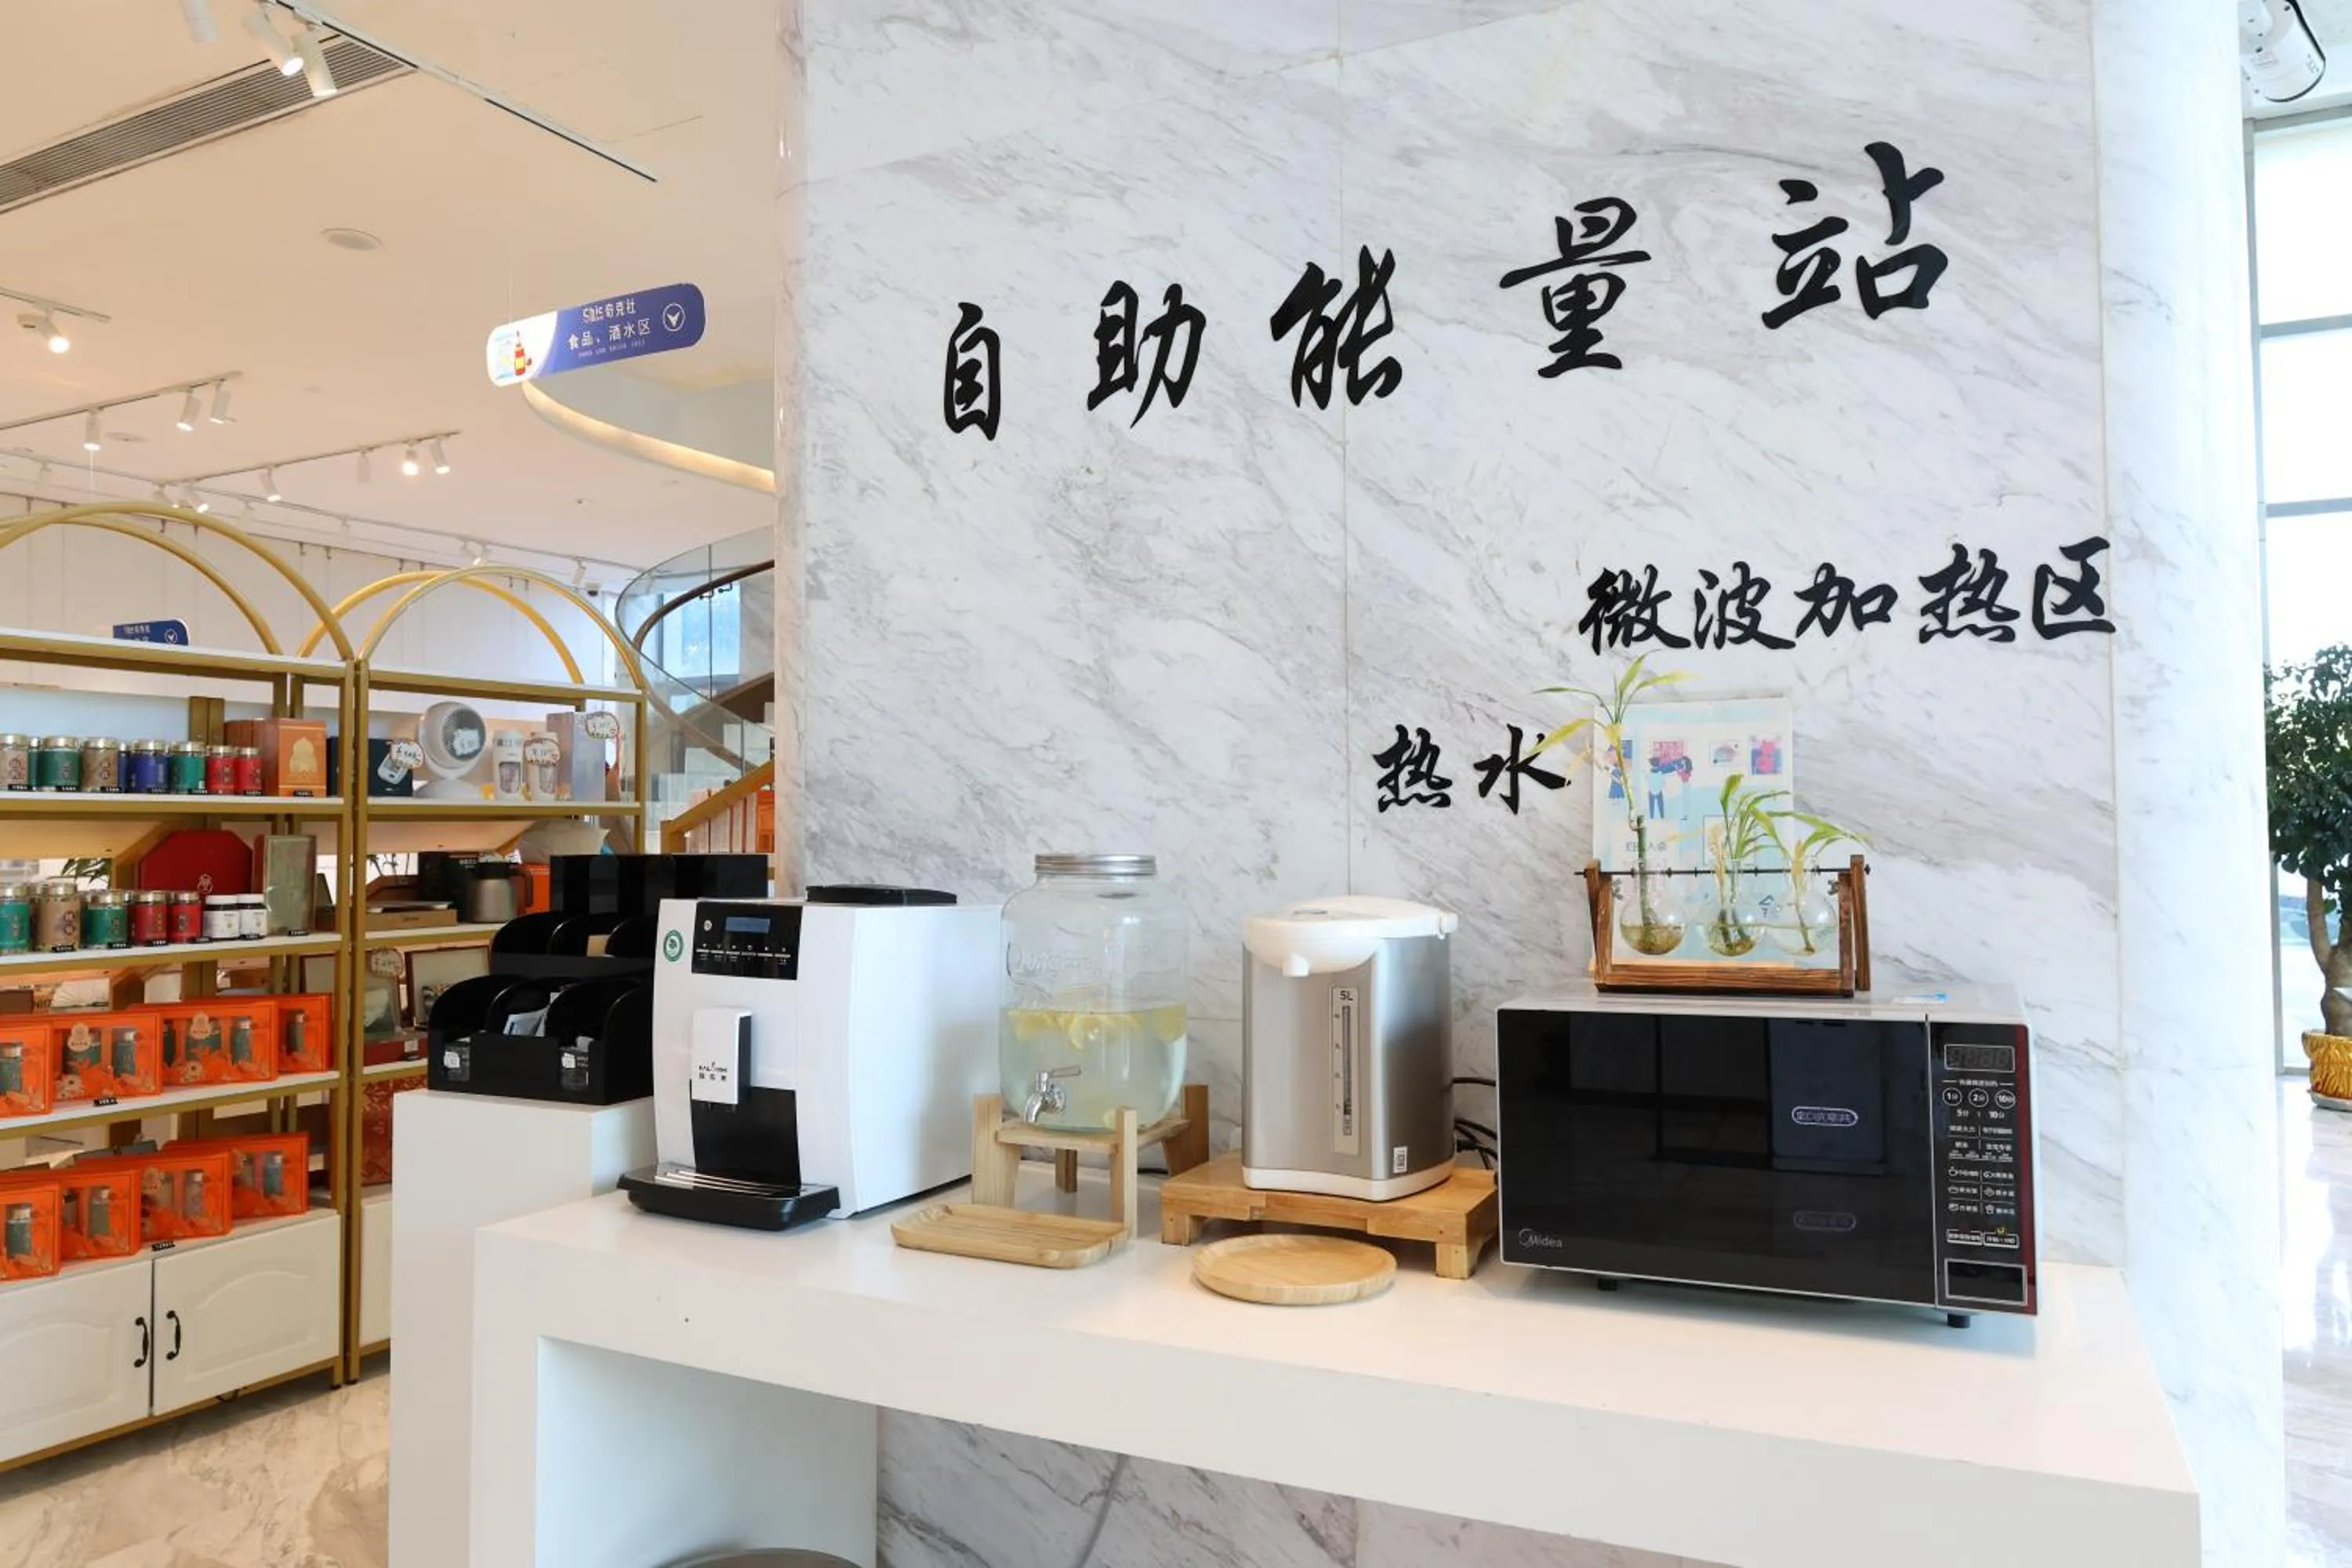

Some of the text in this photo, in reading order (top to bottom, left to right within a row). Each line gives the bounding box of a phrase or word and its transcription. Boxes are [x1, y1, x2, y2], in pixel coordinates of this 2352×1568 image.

[943, 141, 1948, 441] 自助能量站
[1578, 536, 2116, 656] 微波加热区
[1372, 724, 1571, 815] 热水
